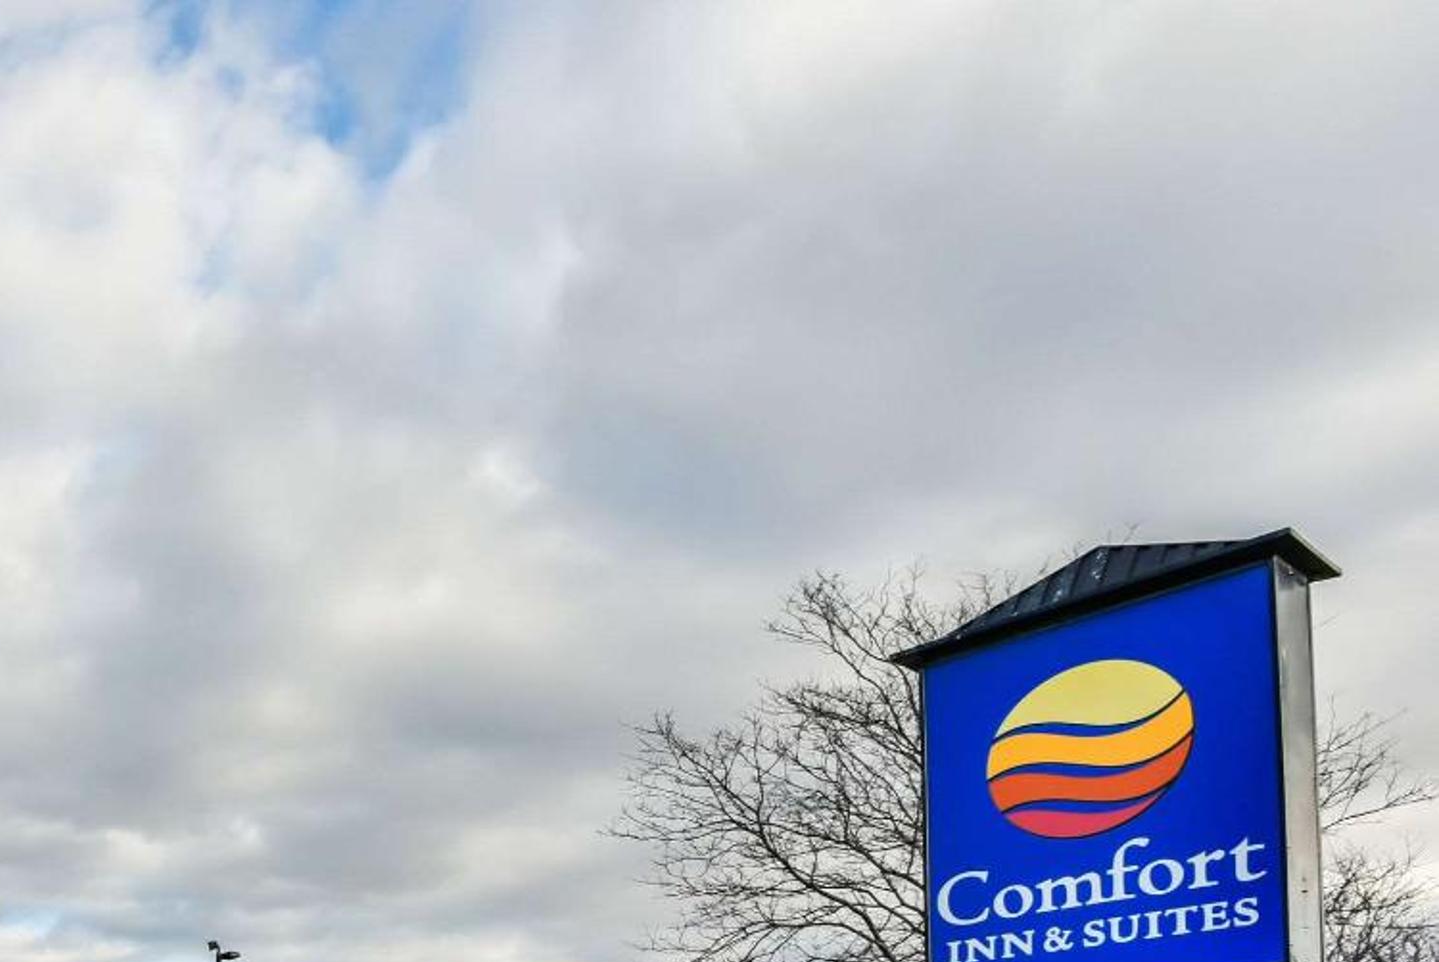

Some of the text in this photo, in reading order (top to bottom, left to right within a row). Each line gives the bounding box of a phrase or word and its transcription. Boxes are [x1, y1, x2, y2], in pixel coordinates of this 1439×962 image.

[937, 836, 1267, 926] Comfort
[1043, 926, 1074, 953] &
[1083, 896, 1260, 949] SUITES
